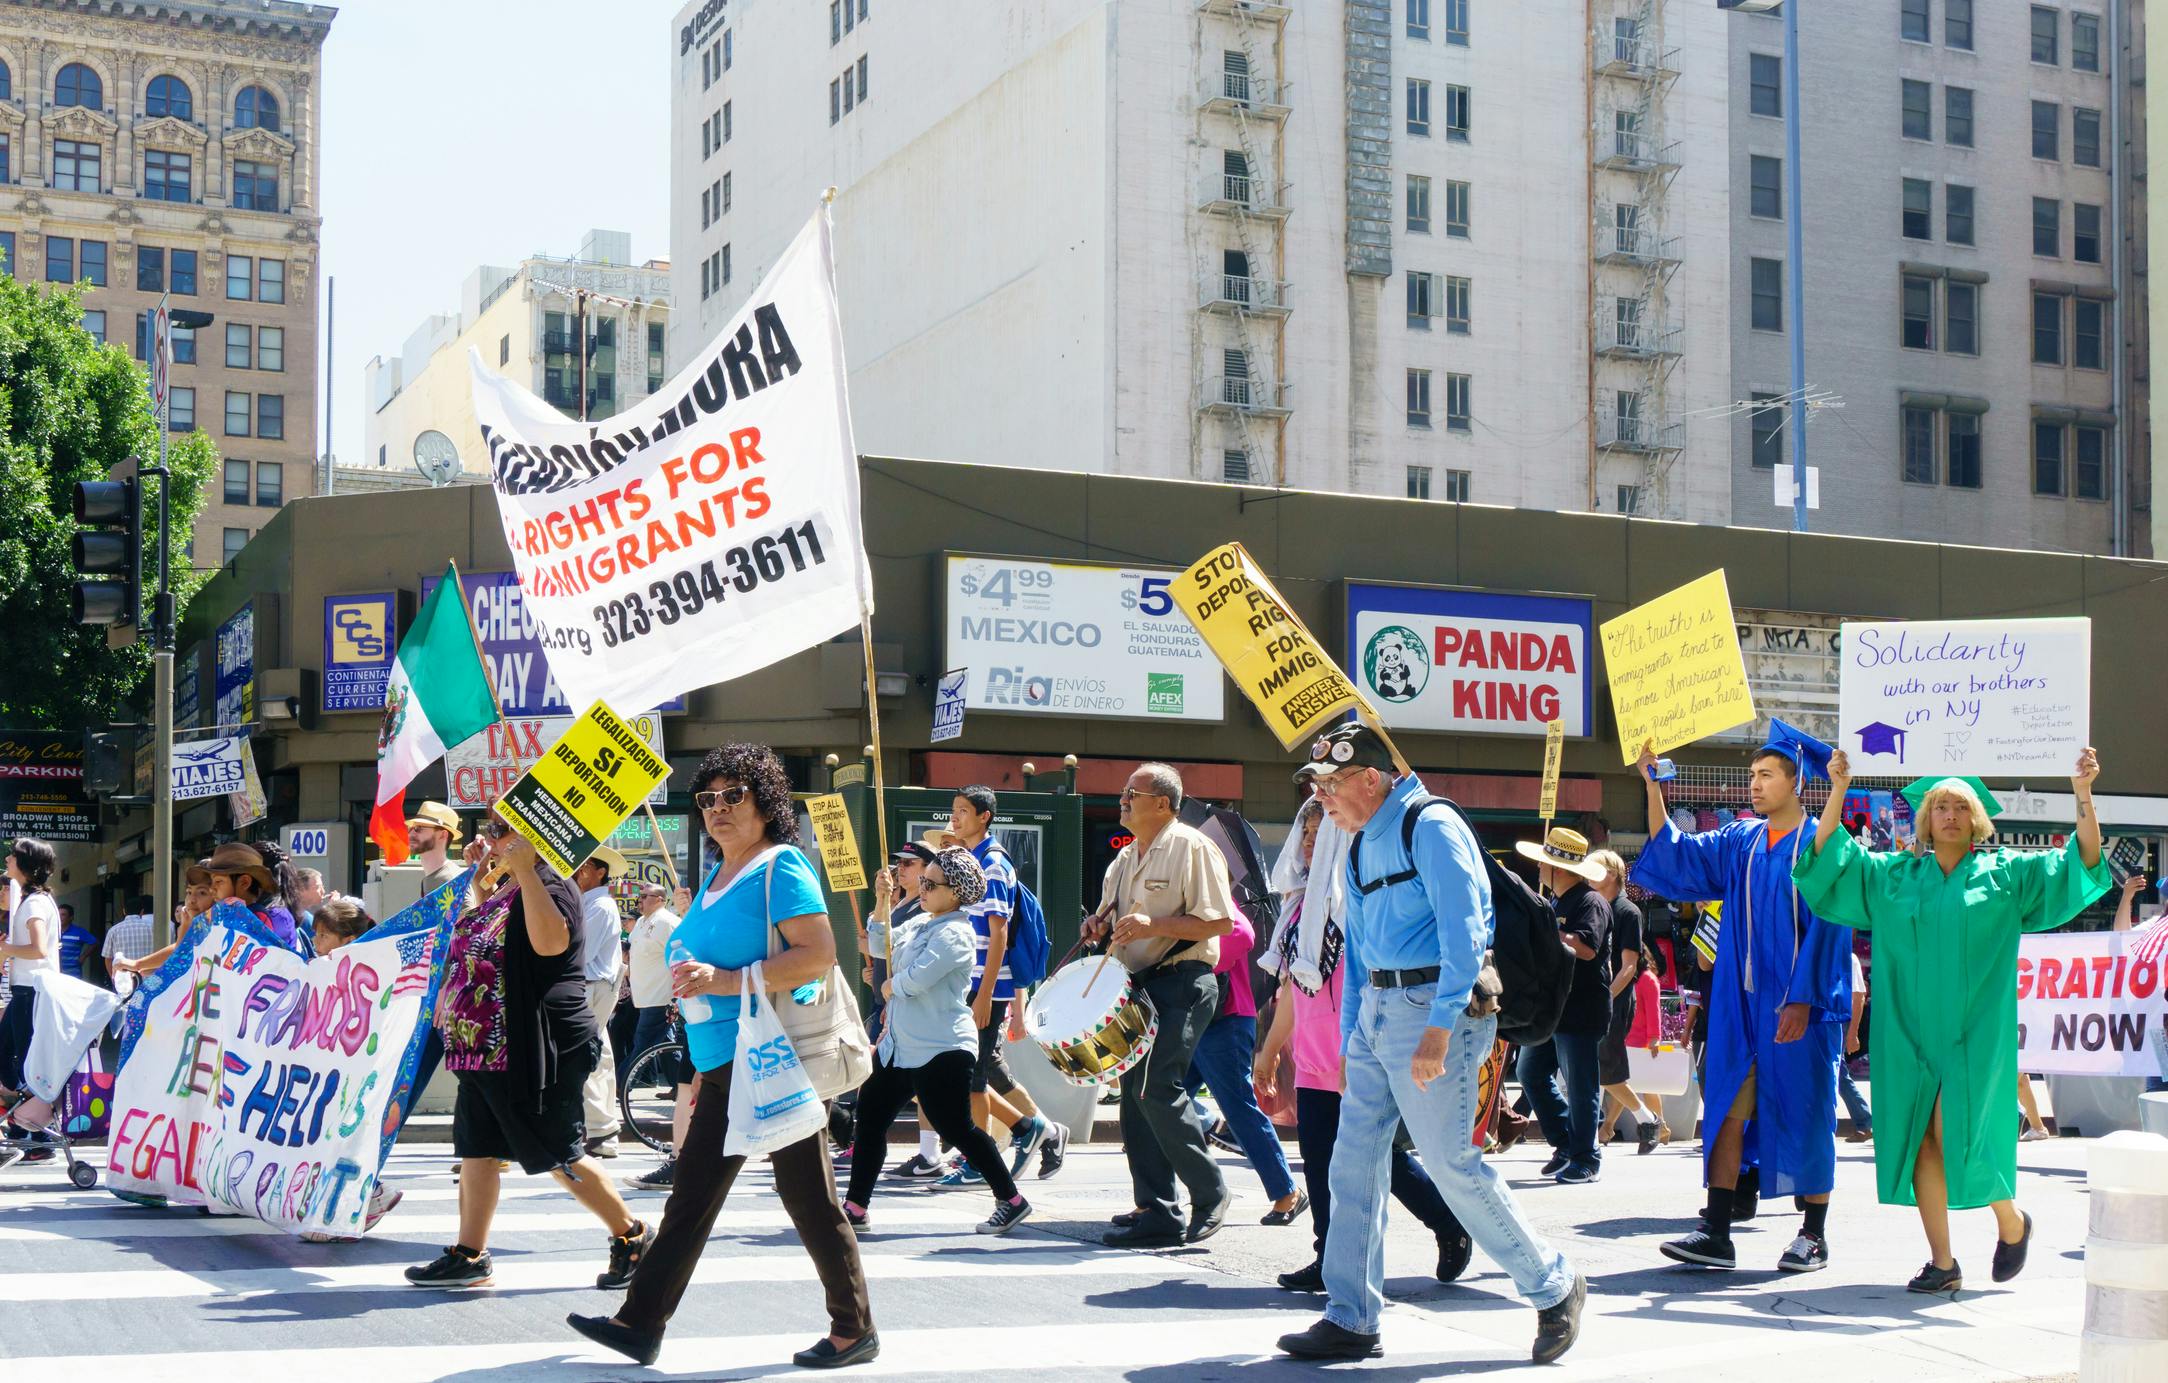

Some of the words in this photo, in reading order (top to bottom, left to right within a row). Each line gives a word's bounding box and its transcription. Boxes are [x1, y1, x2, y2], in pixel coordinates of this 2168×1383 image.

[525, 478, 651, 557] RIGHTS
[661, 427, 766, 499] FOR
[1195, 550, 1237, 590] STO
[474, 586, 540, 642] CHEC
[1196, 574, 1255, 621] DEPOR
[336, 609, 383, 656] CCS
[961, 616, 1101, 647] MEXICO
[1124, 622, 1139, 630] EL
[1142, 622, 1198, 636] SALVADO
[1248, 605, 1285, 637] RIG
[1647, 612, 1693, 646] truth
[1700, 609, 1716, 626] is
[1764, 628, 1809, 649] MTA
[1127, 646, 1202, 658] GUATEMALA
[1130, 634, 1200, 646] HONDURAS
[1265, 631, 1307, 663] FOR
[1434, 626, 1576, 674] PANDA
[1857, 629, 2026, 673] Solidarity
[328, 670, 390, 682] CONTINENTAL
[1258, 651, 1323, 700] IMMIG
[1613, 652, 1674, 692] immigrants
[1680, 640, 1711, 659] tend
[1712, 632, 1725, 651] to
[984, 666, 1053, 707] Ria
[1055, 676, 1106, 692] ENVÍOS
[1150, 692, 1182, 704] AFEX
[1285, 678, 1334, 716] ANSWER
[1453, 680, 1561, 723] KING
[1619, 697, 1633, 714] be
[1634, 692, 1660, 707] more
[1664, 664, 1731, 700] American
[1884, 678, 1925, 697] with
[1932, 682, 1960, 693] our
[1970, 675, 2048, 699] brothers
[934, 700, 964, 727] VIAJES
[1053, 695, 1071, 706] DE
[1073, 696, 1125, 711] DINERO
[1292, 684, 1352, 728] ANSWER
[1622, 721, 1648, 743] than
[1651, 704, 1687, 738] people
[1690, 694, 1714, 715] born
[1906, 709, 1931, 726] in
[1946, 699, 1982, 727] NY
[486, 722, 545, 760] TAX
[590, 706, 663, 779] LEGALIZACION
[1945, 748, 1969, 764] NY
[172, 761, 243, 789] VIAJES
[554, 743, 628, 816] DEPORTACION
[592, 747, 627, 779] SÍ
[172, 782, 240, 800] 213.627-6157
[454, 767, 540, 804] CHE
[563, 785, 586, 809] NO
[3, 813, 53, 821] BROADWAY
[530, 799, 573, 843] MEXICANA
[535, 787, 585, 838] HERMANDAD
[813, 801, 826, 812] STOP
[828, 799, 840, 810] ALL
[2004, 798, 2046, 815] TAR
[35, 832, 90, 840] COMMISSION)
[292, 831, 326, 854] 400
[511, 795, 577, 863] TRANSNACIONAL
[826, 849, 837, 858] FOR
[838, 846, 850, 856] ALL
[2017, 955, 2168, 1000] GRATIO
[2051, 1013, 2147, 1052] NOW
[747, 1035, 795, 1071] OSS
